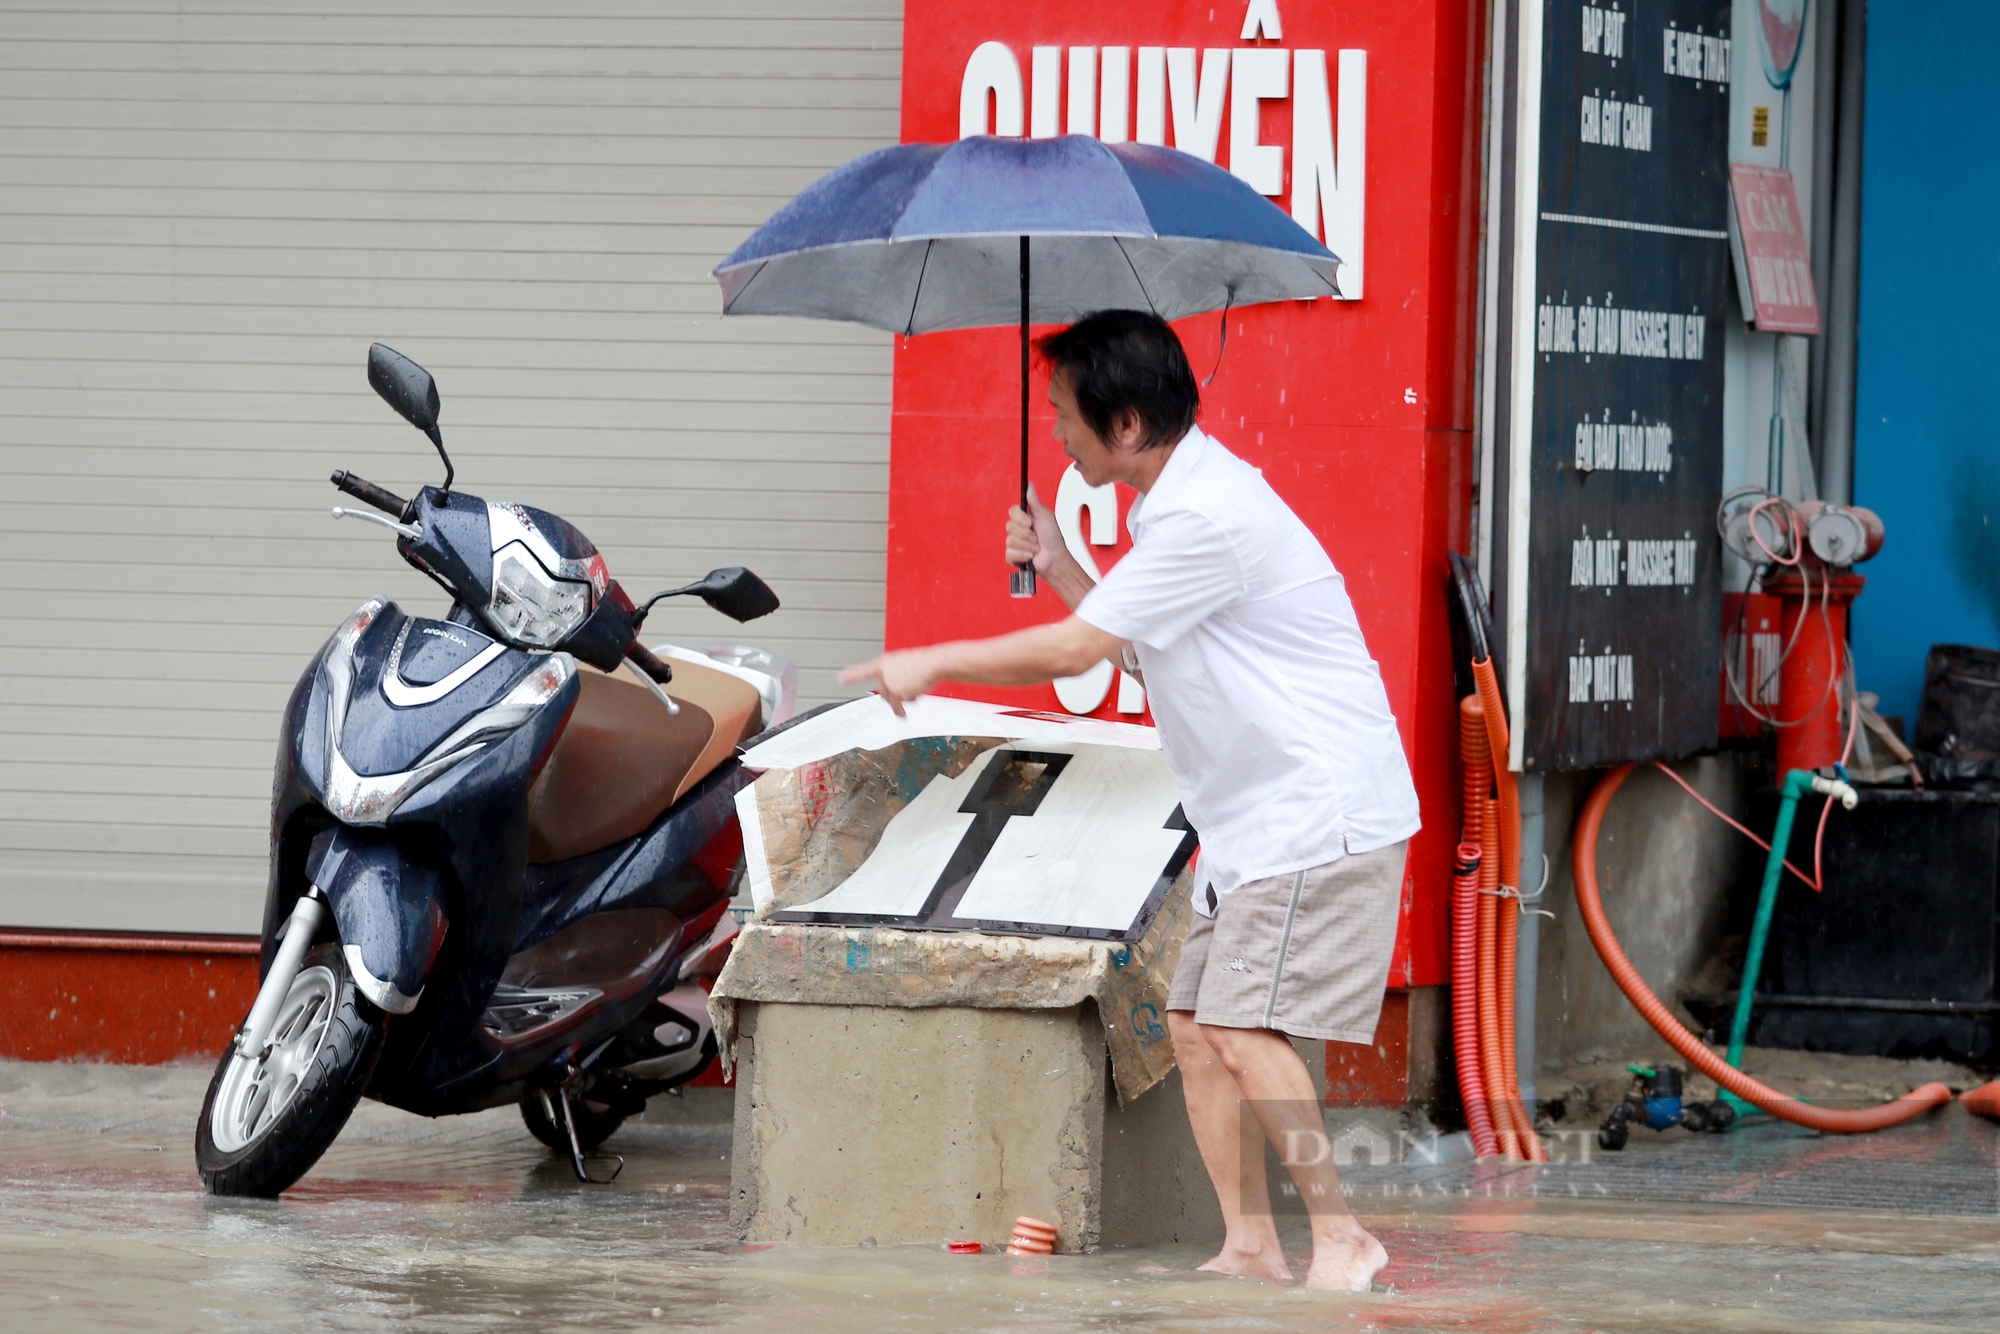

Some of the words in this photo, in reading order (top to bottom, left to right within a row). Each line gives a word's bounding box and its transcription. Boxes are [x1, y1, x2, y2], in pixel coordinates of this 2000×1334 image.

[1620, 308, 1668, 358] MASSAGE
[1668, 312, 1685, 359] VAI
[1626, 539, 1674, 587] MASSAGE
[422, 627, 467, 648] HONDA
